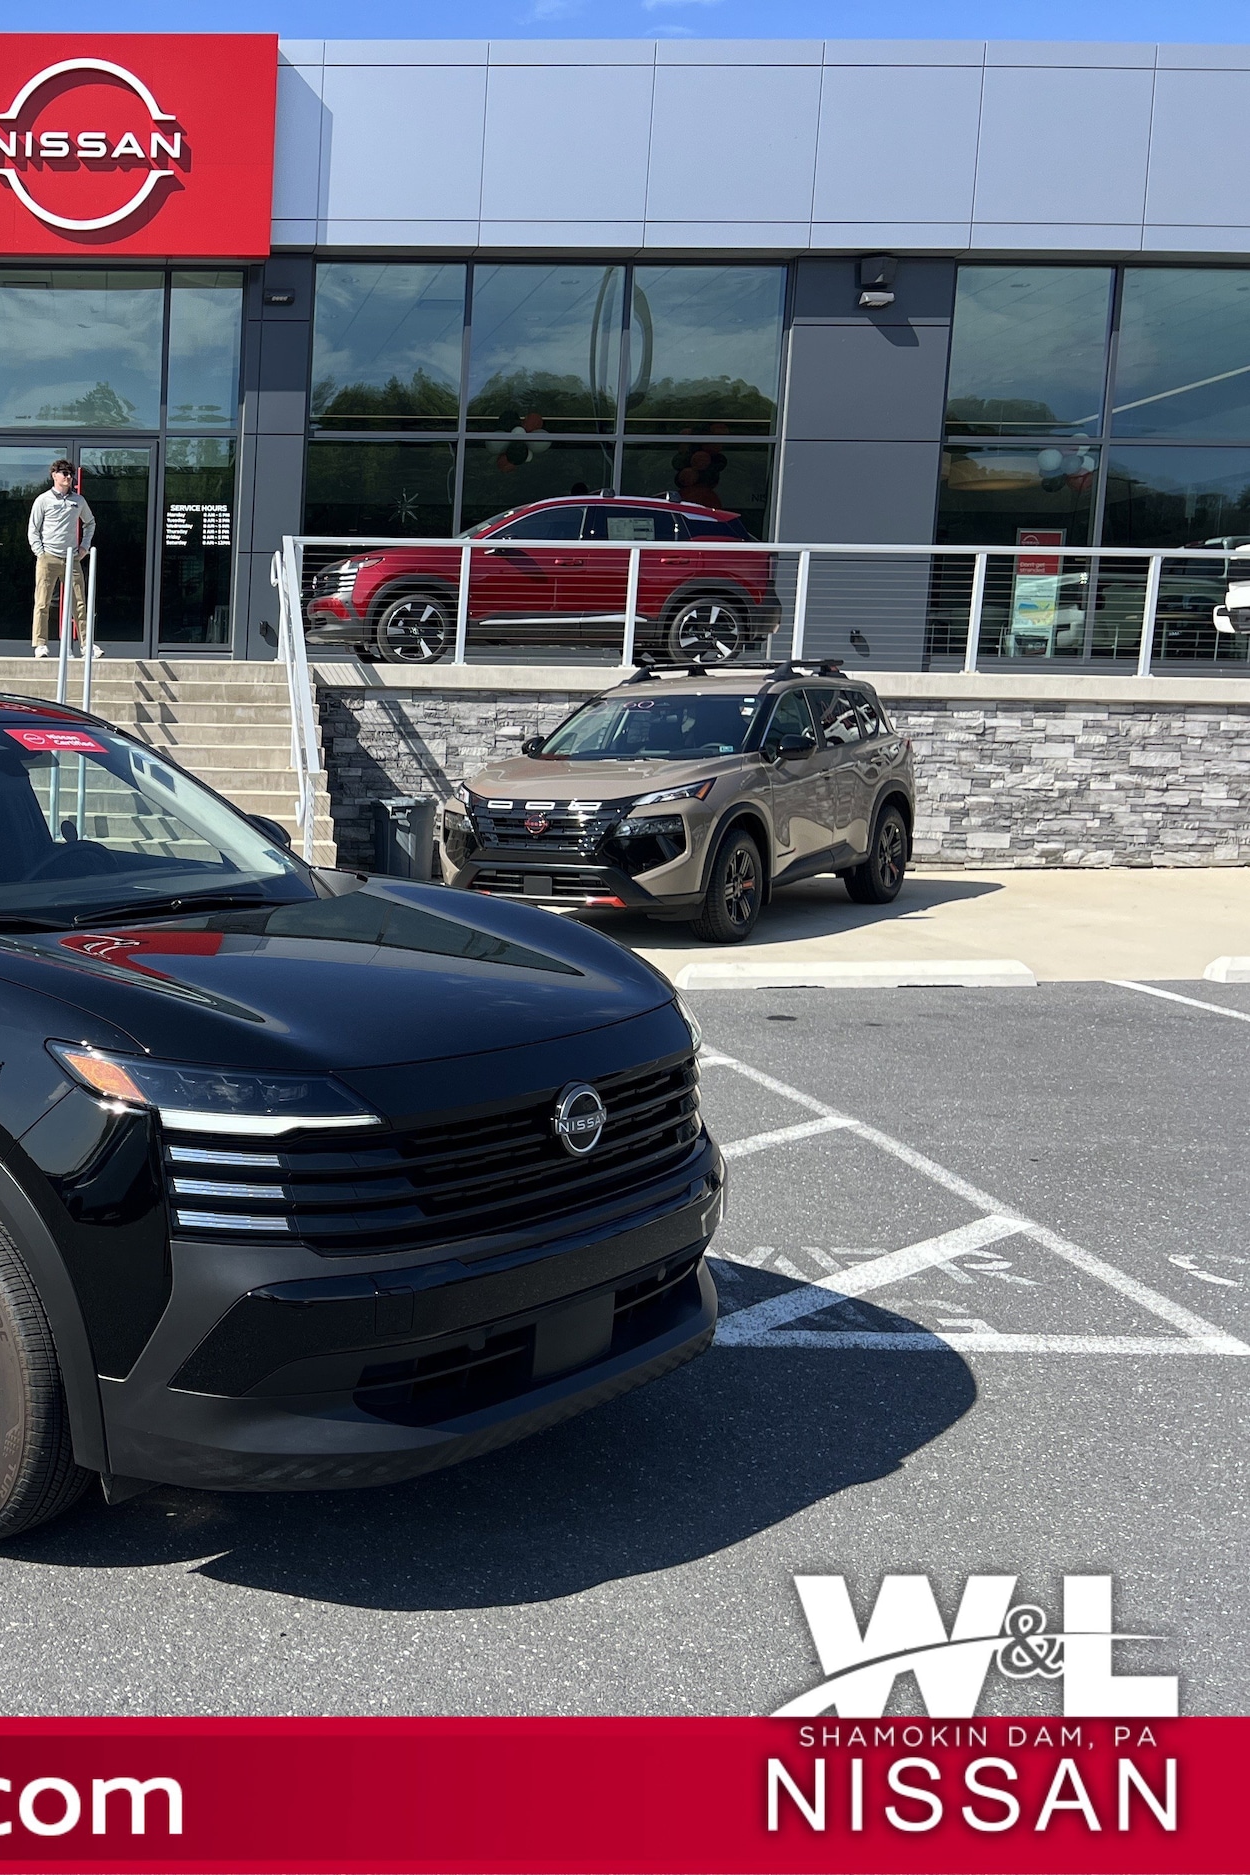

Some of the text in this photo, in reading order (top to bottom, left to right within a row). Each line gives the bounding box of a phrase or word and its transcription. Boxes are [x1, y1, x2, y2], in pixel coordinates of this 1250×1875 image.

[170, 504, 228, 512] SERVICE HOURS
[558, 1111, 607, 1133] NISSAN
